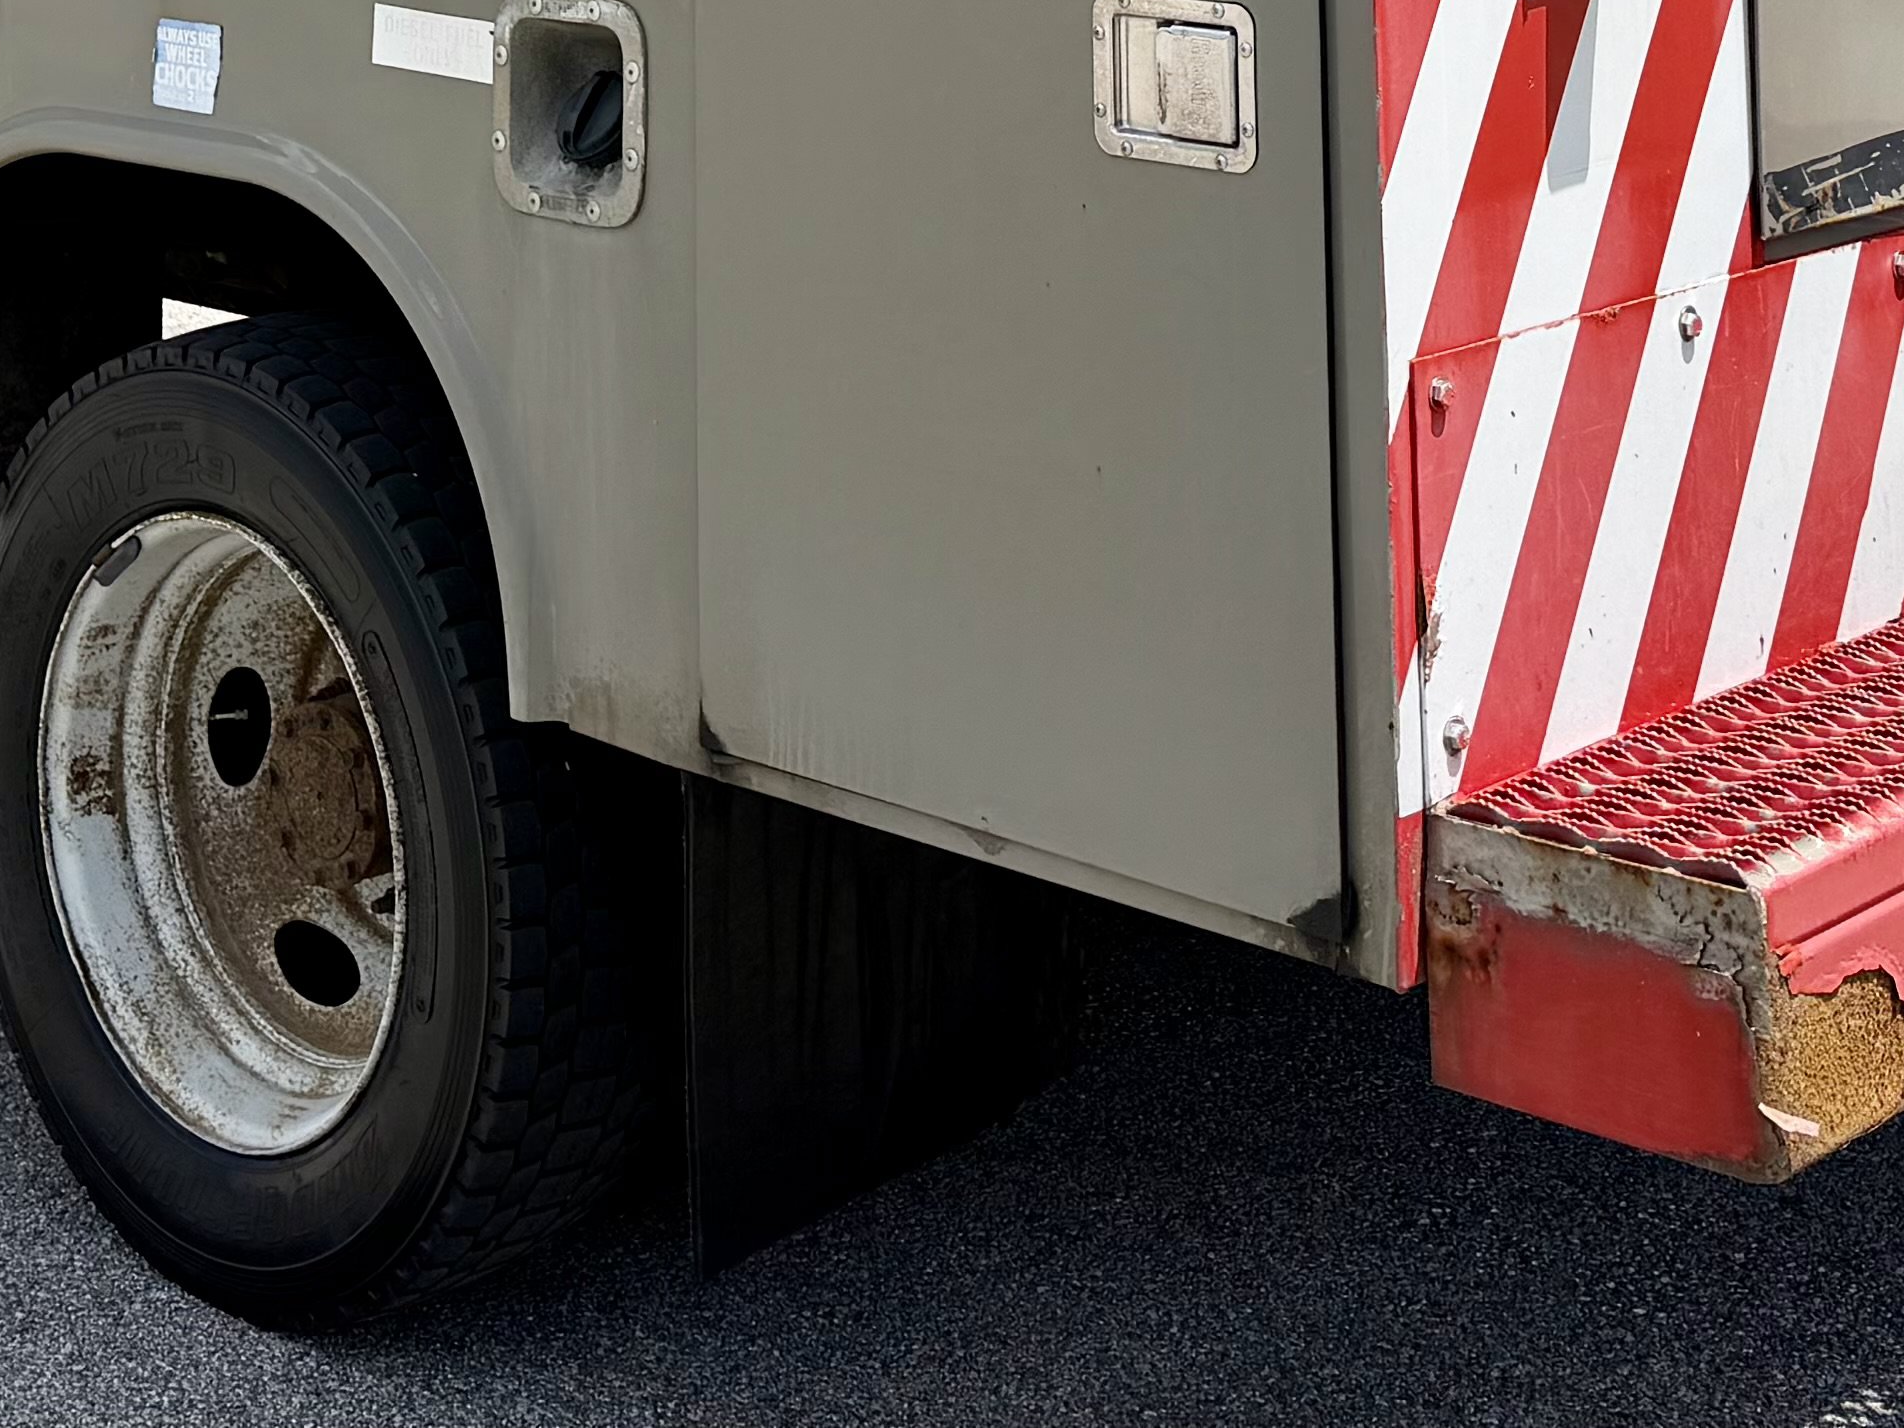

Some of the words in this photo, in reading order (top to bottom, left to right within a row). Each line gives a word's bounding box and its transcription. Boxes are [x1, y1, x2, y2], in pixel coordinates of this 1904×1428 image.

[384, 13, 436, 42] DIESEL
[164, 43, 207, 67] WHEEL
[155, 63, 216, 92] CHOCKS
[63, 439, 237, 531] M729
